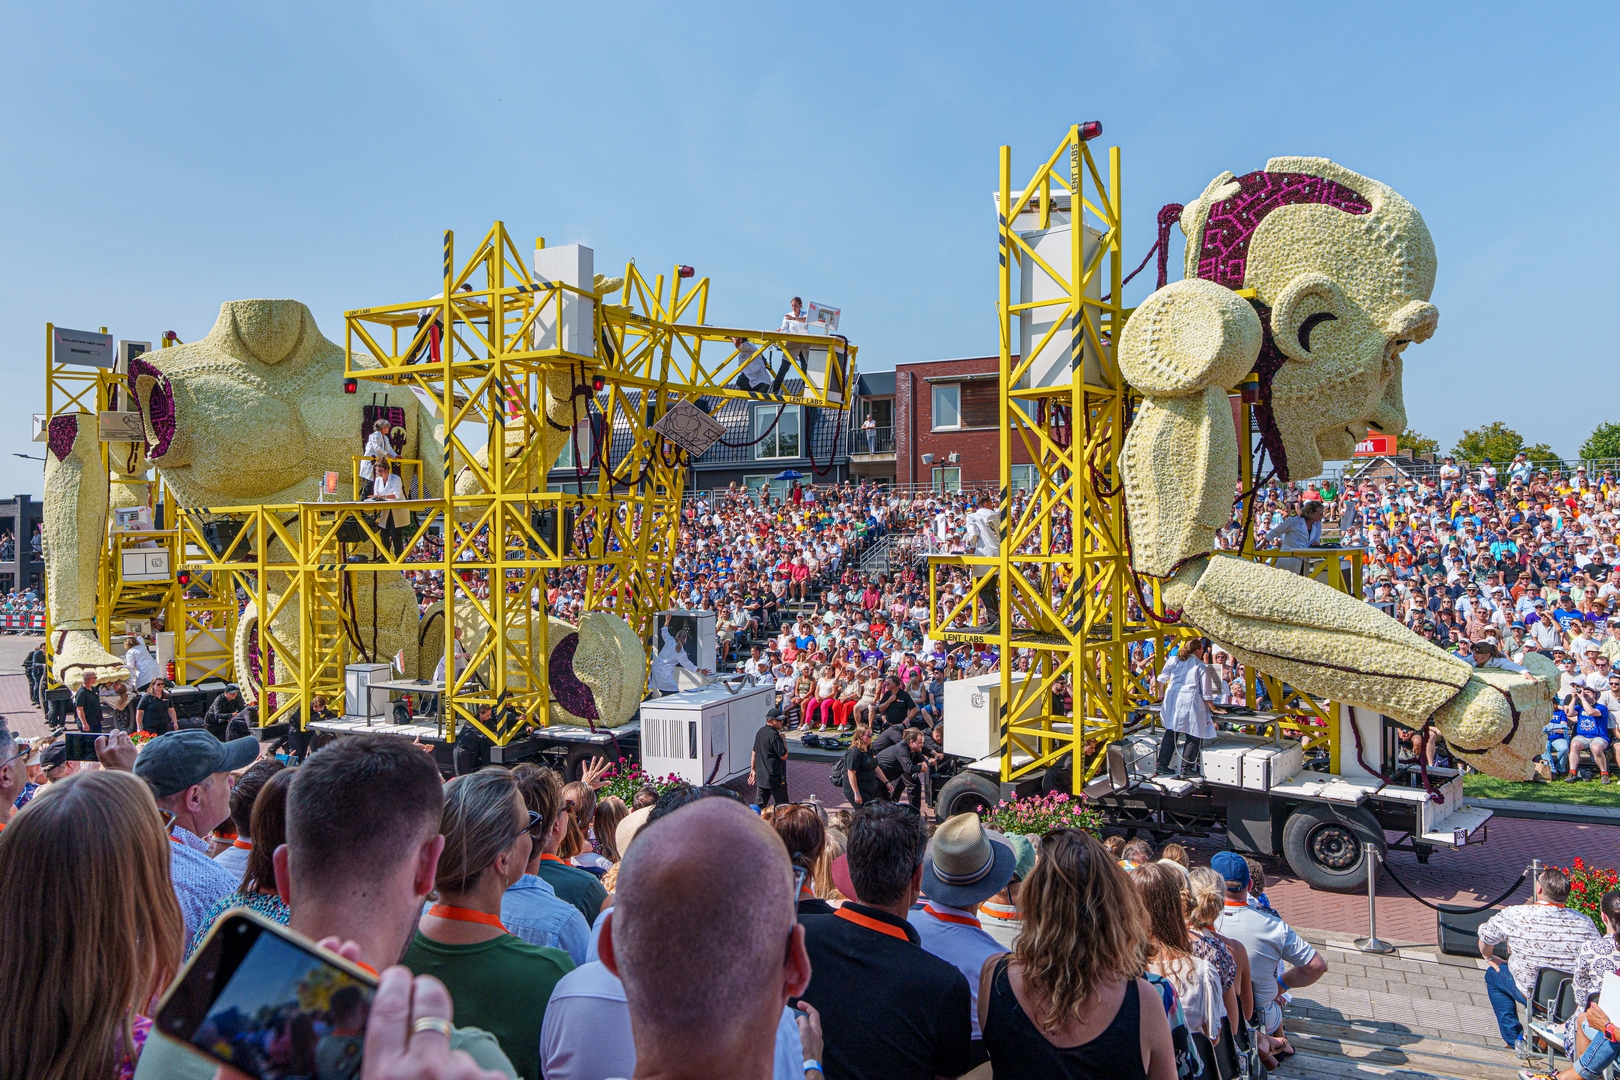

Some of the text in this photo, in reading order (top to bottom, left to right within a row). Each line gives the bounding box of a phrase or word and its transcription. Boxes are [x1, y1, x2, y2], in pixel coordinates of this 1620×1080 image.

[1071, 143, 1079, 196] LENT LABS
[790, 396, 805, 404] LENT
[943, 633, 984, 644] LENT LABS
